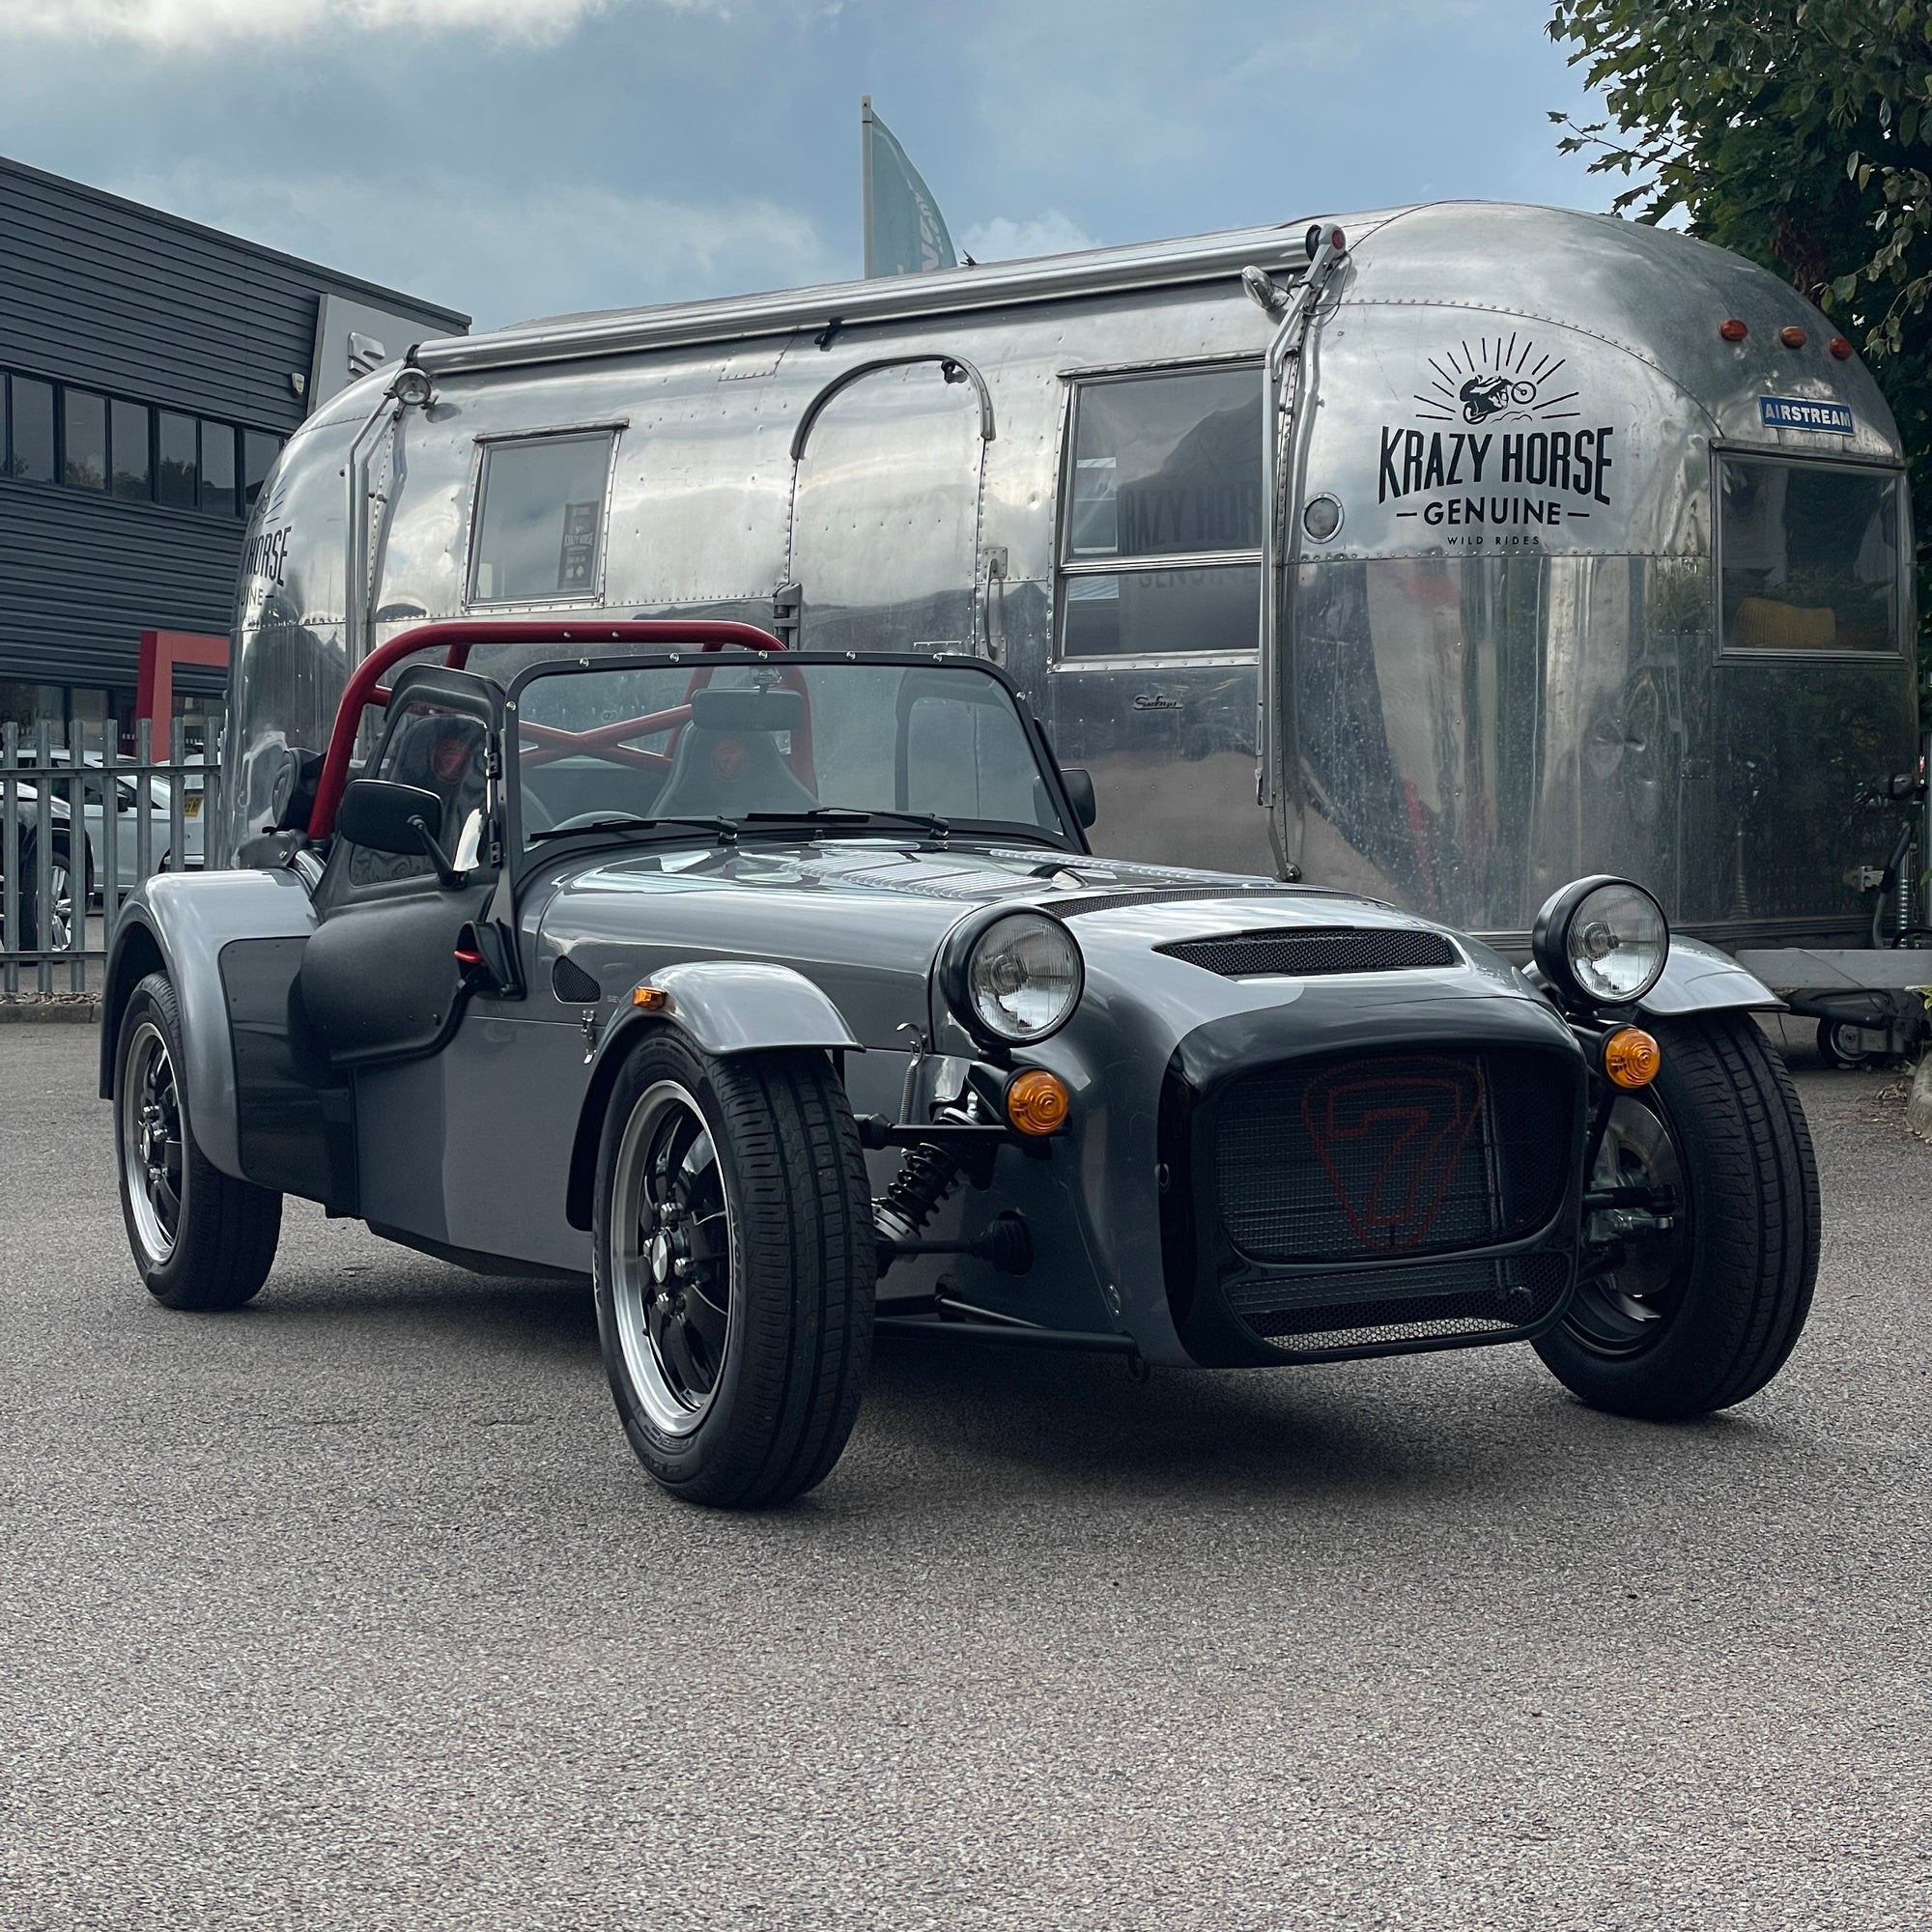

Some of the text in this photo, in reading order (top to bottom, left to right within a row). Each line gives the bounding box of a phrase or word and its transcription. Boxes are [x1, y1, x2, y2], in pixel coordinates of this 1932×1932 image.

[1765, 403, 1851, 427] AIRSTREAM
[1378, 426, 1613, 505] KRAZY HORSE
[1424, 497, 1561, 525] GENUINE
[246, 526, 292, 586] HORSE
[1447, 536, 1540, 545] WILD RIDES
[1326, 1076, 1462, 1226] 7
